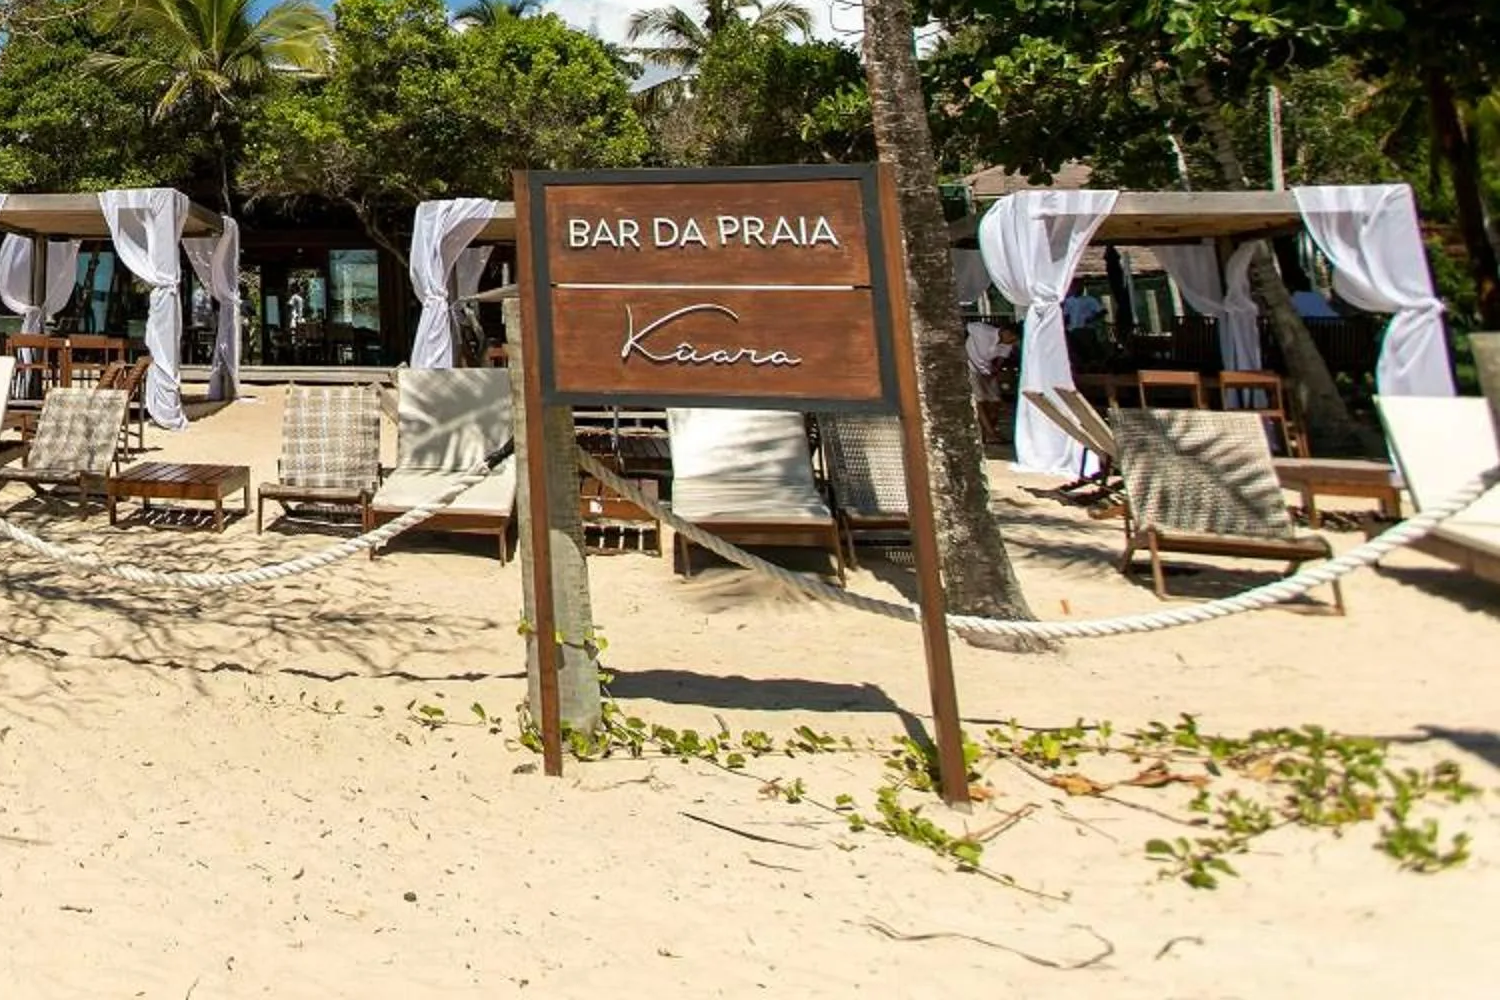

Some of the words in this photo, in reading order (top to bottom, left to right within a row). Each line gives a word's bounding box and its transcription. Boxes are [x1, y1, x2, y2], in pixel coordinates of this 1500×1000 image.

[568, 219, 640, 248] BAR
[653, 217, 707, 247] DA
[717, 215, 840, 247] PRAIA
